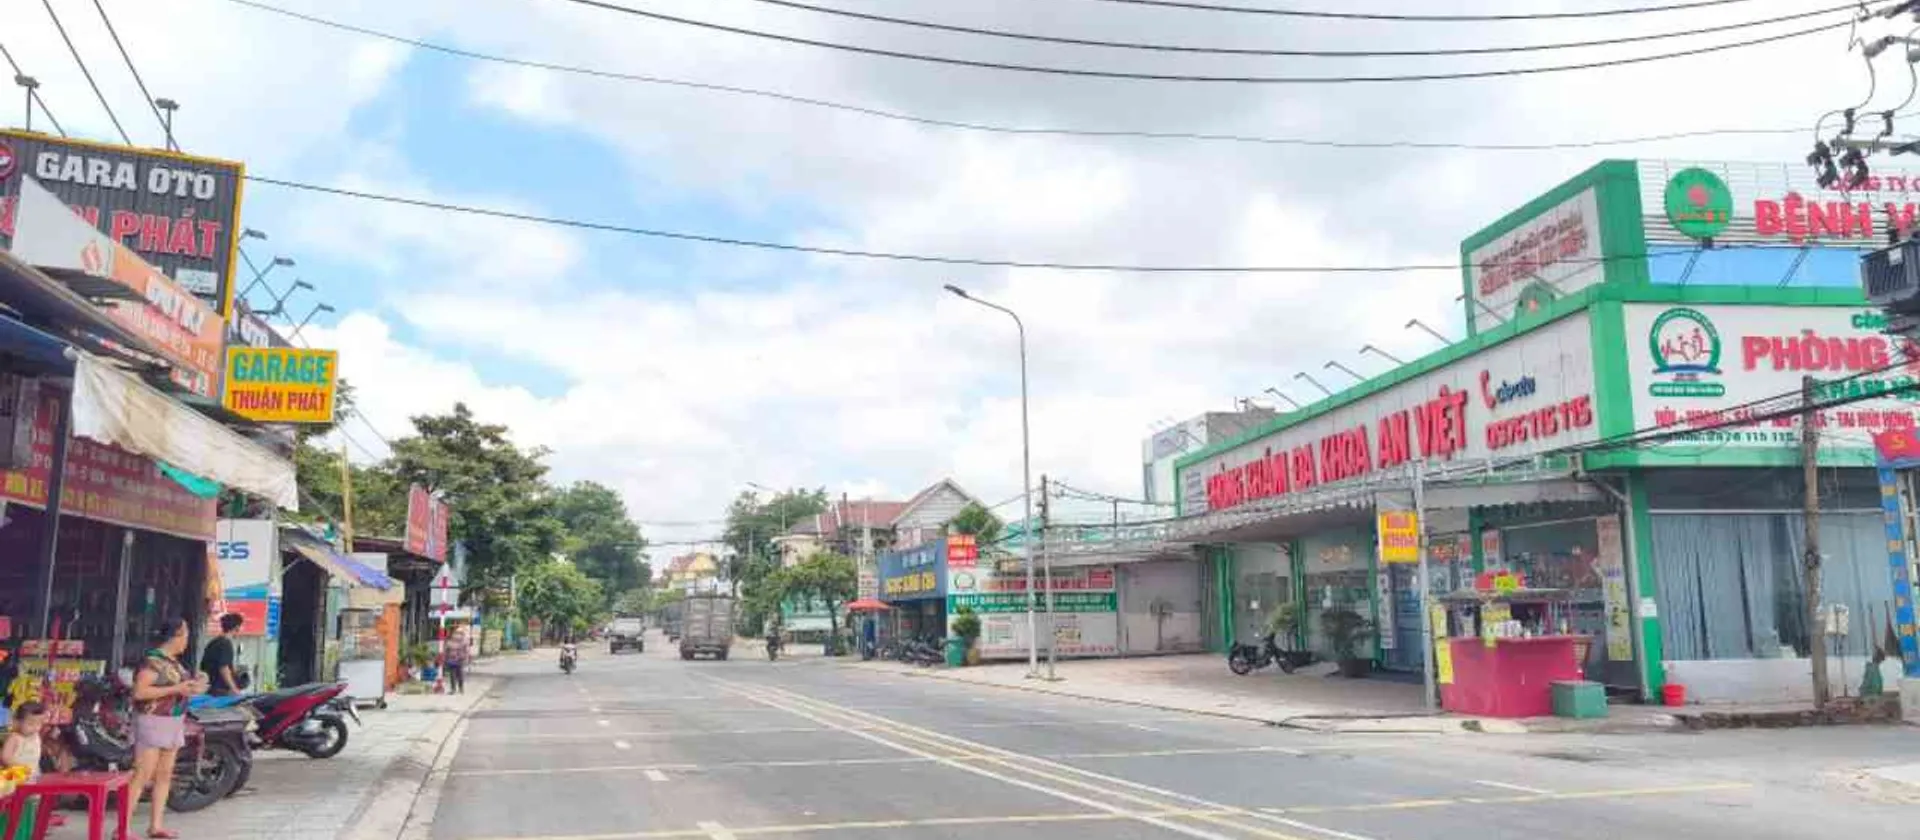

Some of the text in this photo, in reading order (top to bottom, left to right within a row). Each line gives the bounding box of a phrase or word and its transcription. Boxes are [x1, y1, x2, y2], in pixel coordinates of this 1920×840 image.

[35, 151, 137, 191] GARA
[111, 206, 221, 259] PHÁT
[1754, 191, 1873, 246] BỆNH
[233, 351, 330, 386] GARAGE
[1741, 327, 1890, 372] PHÒNG
[287, 387, 329, 413] PHÁT
[1245, 446, 1290, 502] KHÁM
[1320, 423, 1372, 484] KHOA
[1377, 409, 1411, 469] AN
[1413, 384, 1468, 461] VIỆT
